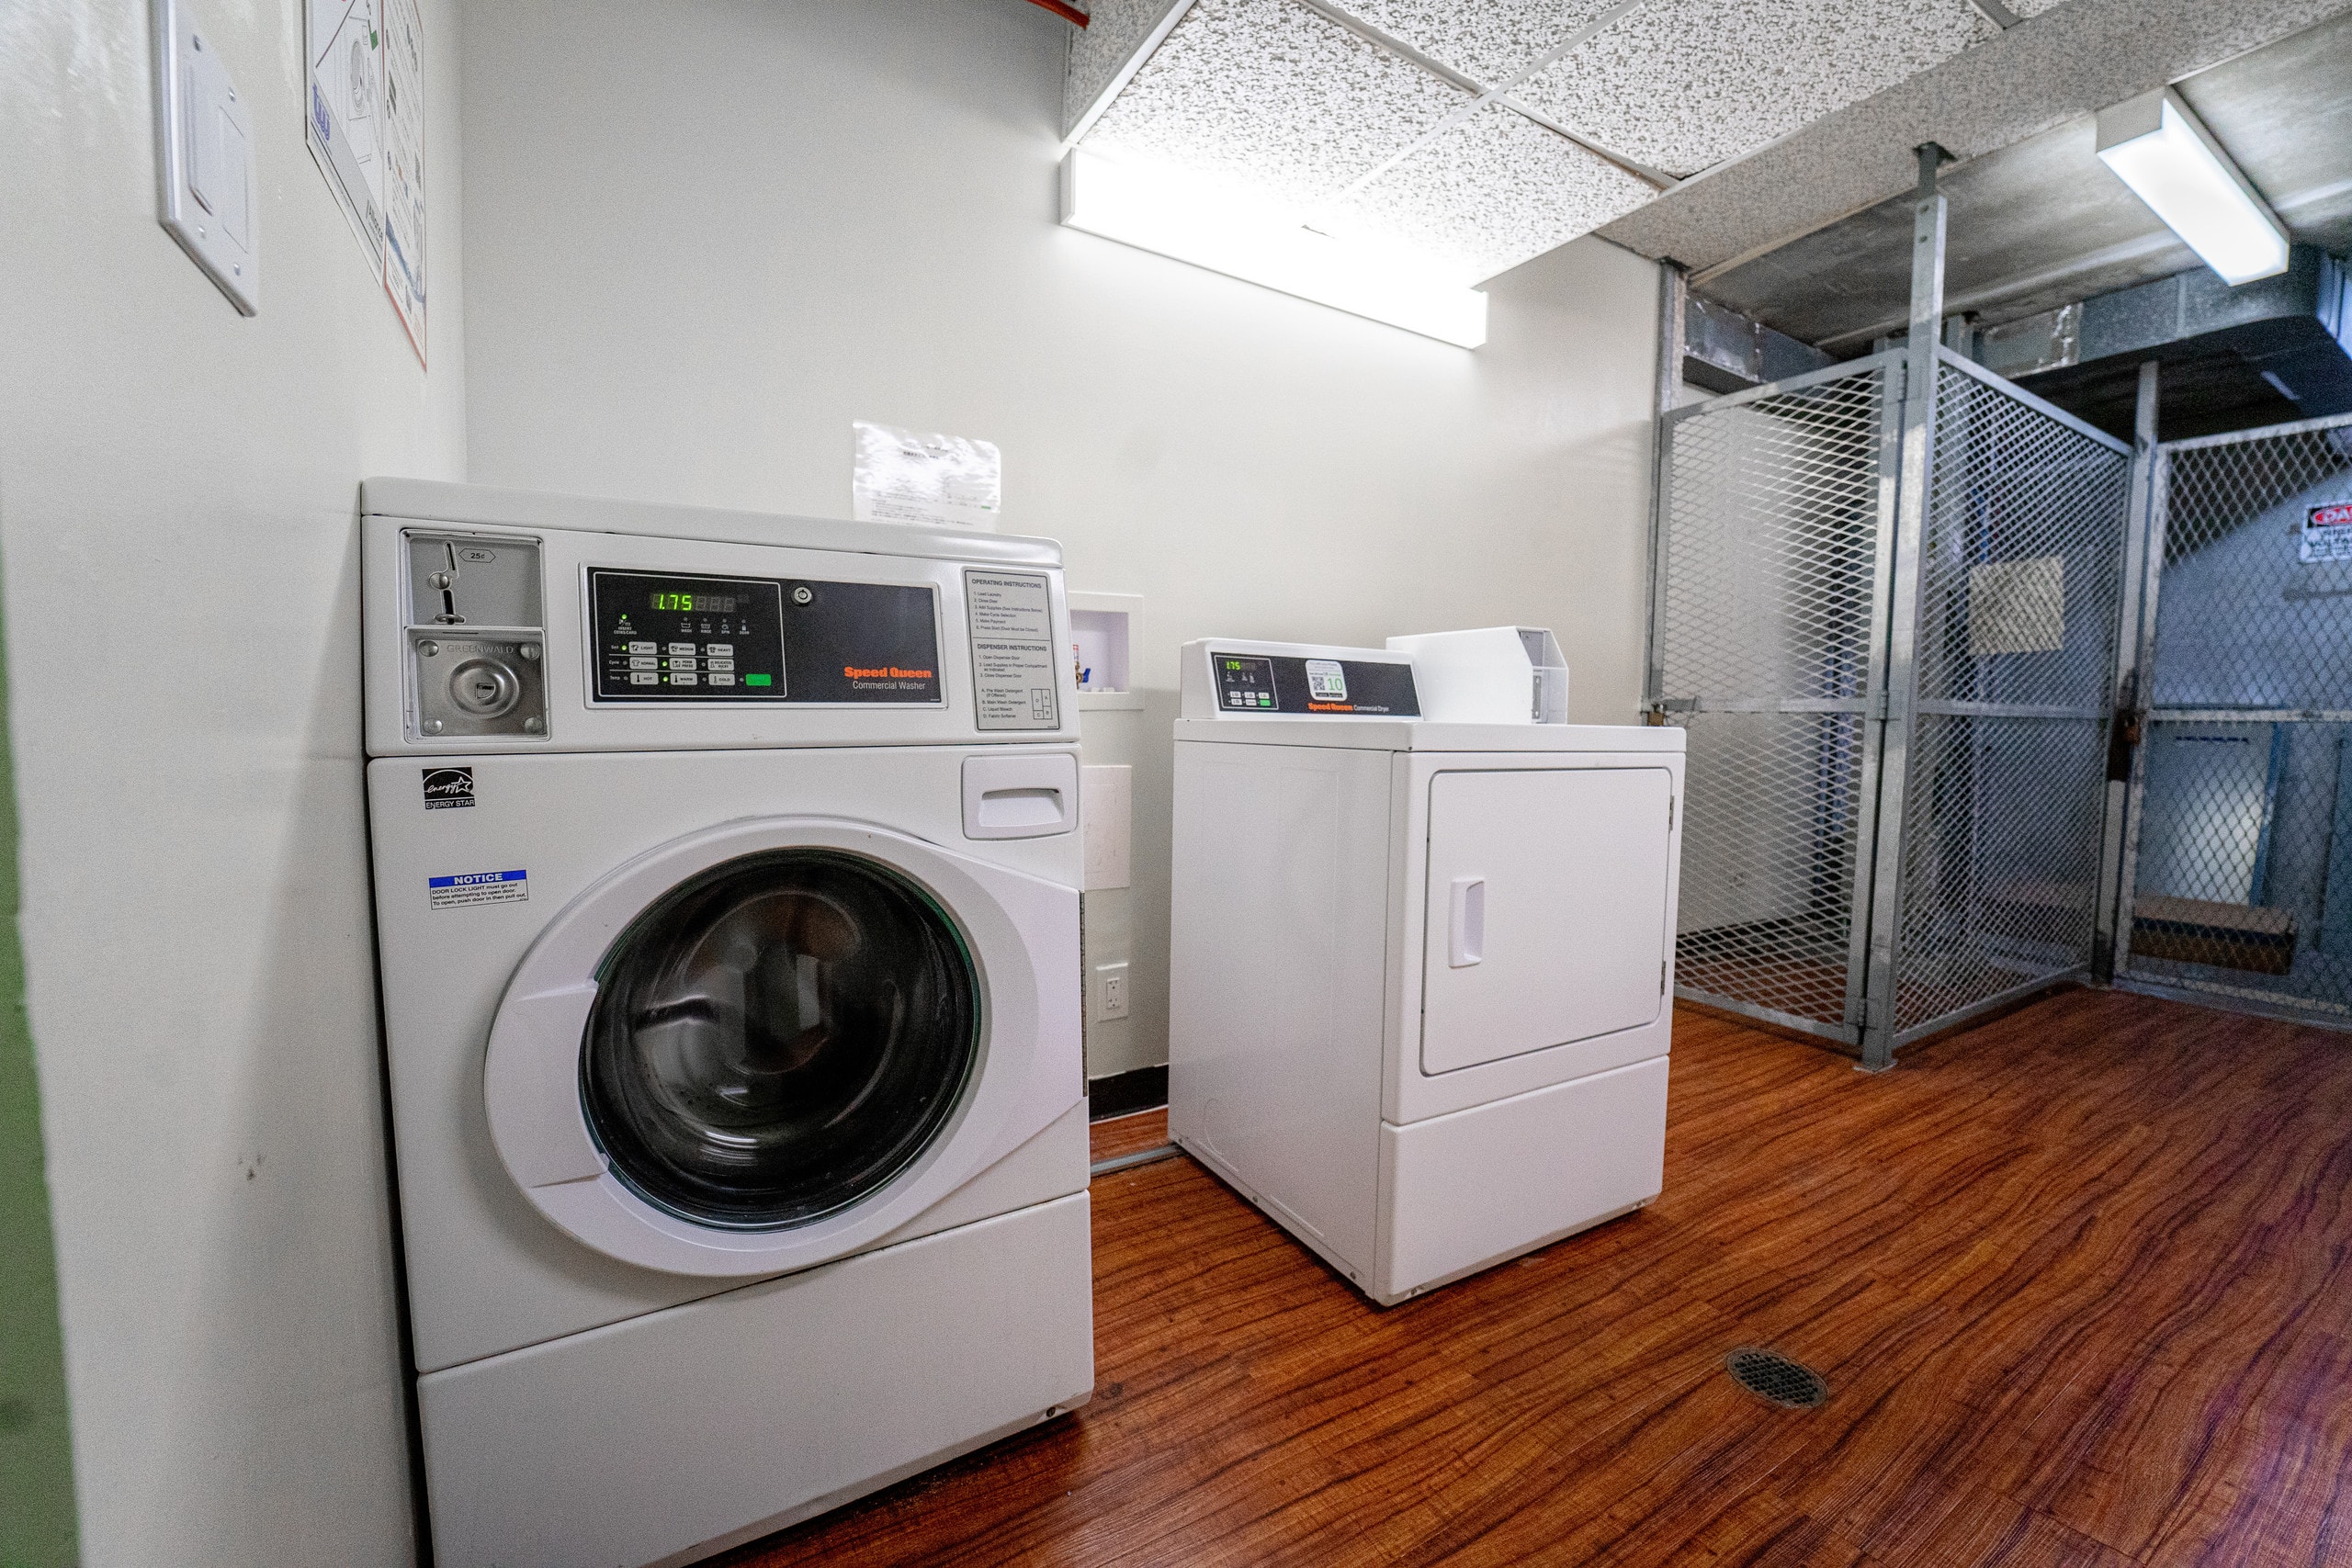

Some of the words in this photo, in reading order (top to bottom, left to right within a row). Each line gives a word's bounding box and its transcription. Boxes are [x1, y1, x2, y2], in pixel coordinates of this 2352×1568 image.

[2323, 507, 2352, 525] DA
[447, 645, 514, 653] GREENWALD
[844, 667, 888, 679] Speed
[889, 667, 933, 678] Queen
[853, 681, 897, 690] Commercial
[899, 682, 925, 690] Washer
[1308, 703, 1330, 711] Speed
[454, 873, 503, 885] NOTICE
